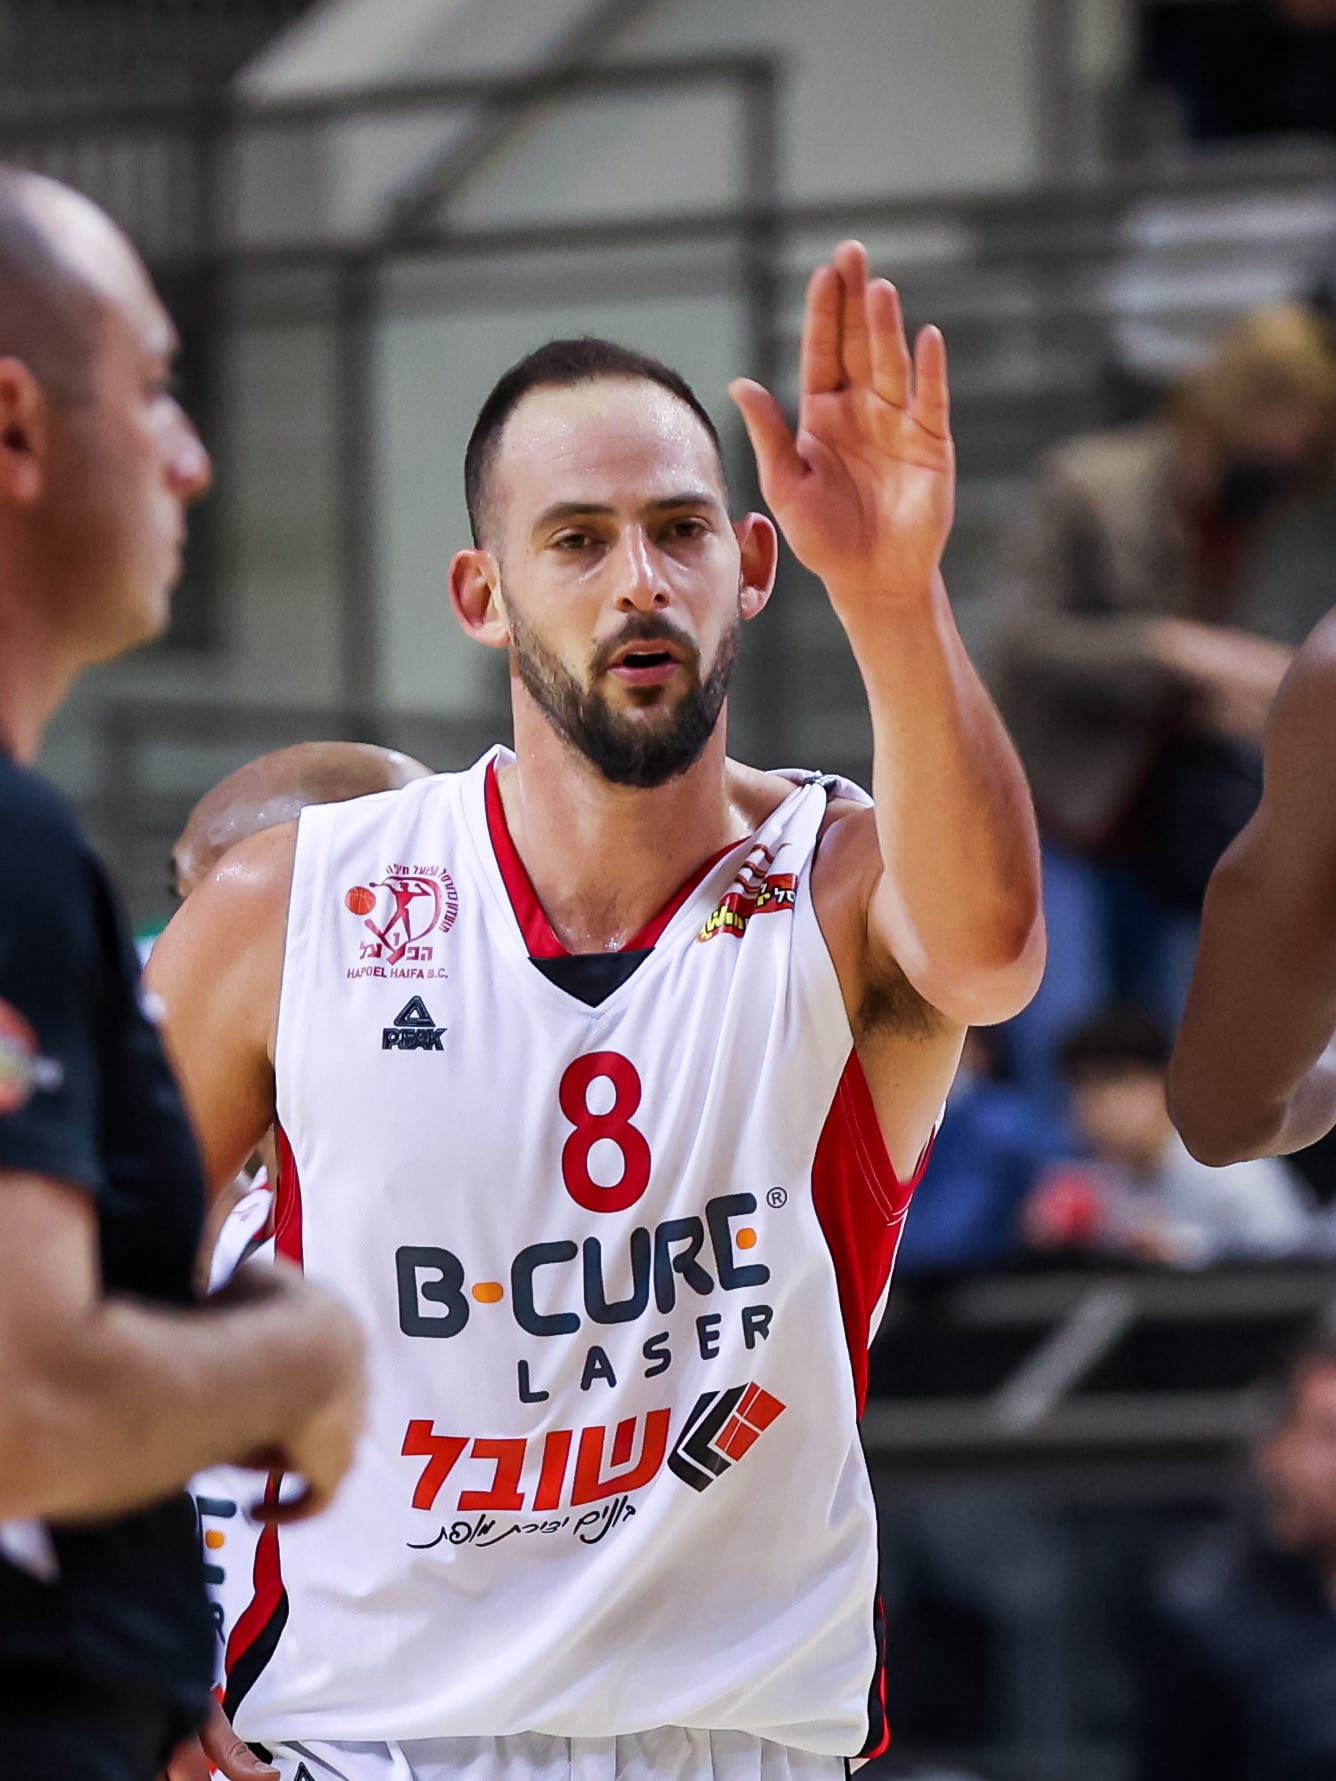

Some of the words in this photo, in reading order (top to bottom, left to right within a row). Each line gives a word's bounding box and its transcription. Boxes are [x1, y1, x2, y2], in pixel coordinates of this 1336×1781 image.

[347, 966, 387, 979] HAPOEL
[390, 967, 425, 979] HAIFA
[427, 967, 449, 979] B.C.
[382, 1027, 448, 1051] PEAK
[559, 1050, 652, 1213] 8
[517, 1304, 774, 1403] LASER
[400, 1407, 672, 1512] שובל
[406, 1513, 497, 1549] מופת
[573, 1494, 637, 1545] בונים
